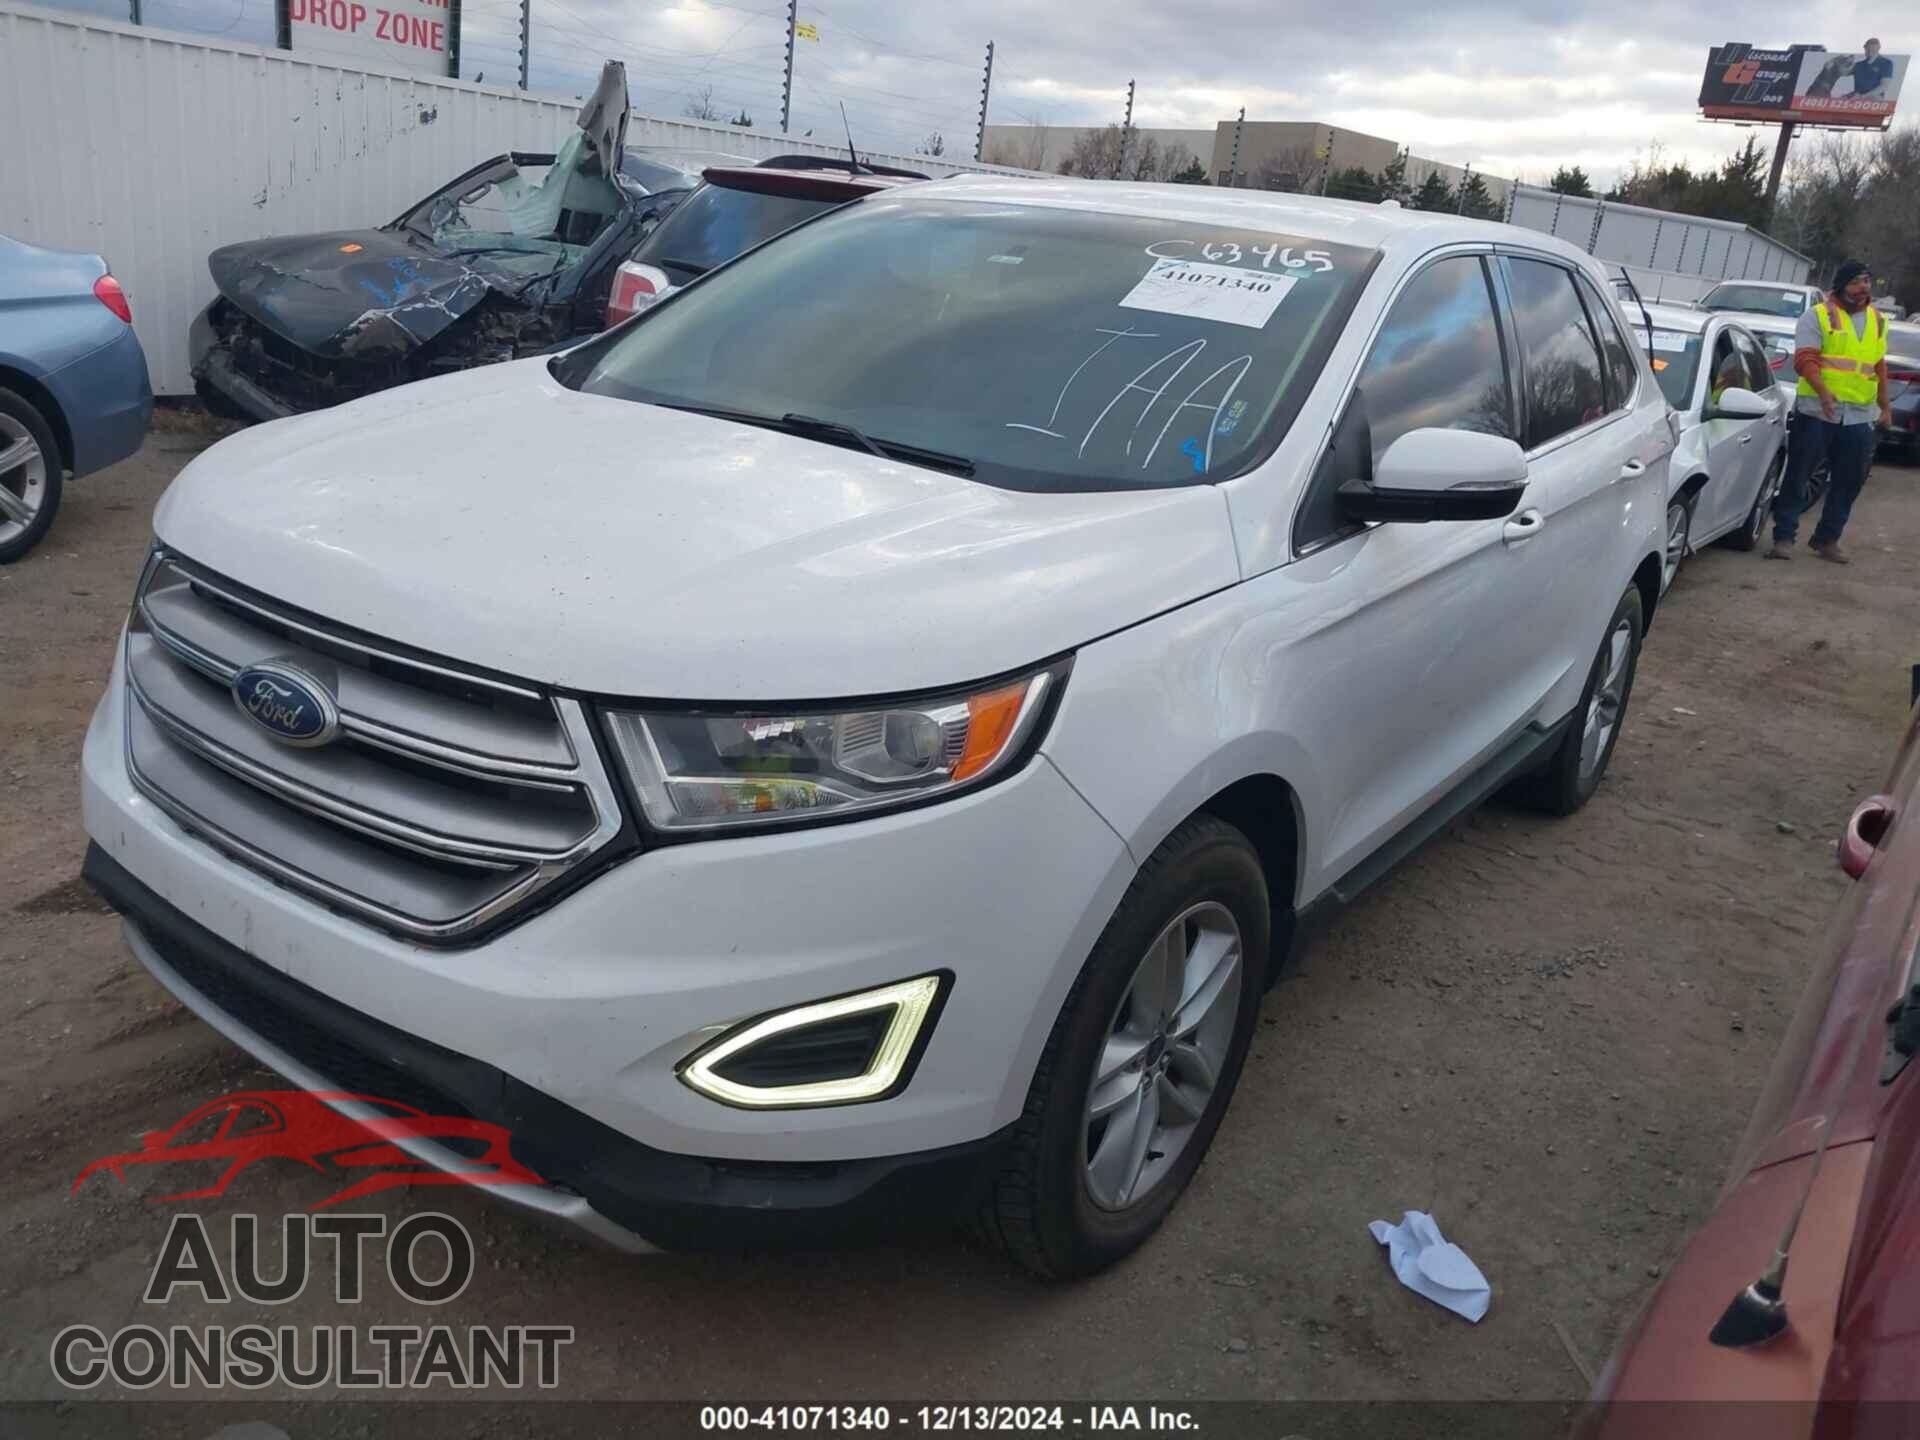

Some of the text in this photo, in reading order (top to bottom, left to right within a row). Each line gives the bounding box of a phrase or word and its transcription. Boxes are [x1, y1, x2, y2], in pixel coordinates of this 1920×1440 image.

[290, 0, 444, 51] DROP ZONE
[1160, 269, 1272, 294] 41071340
[249, 679, 304, 729] Ford
